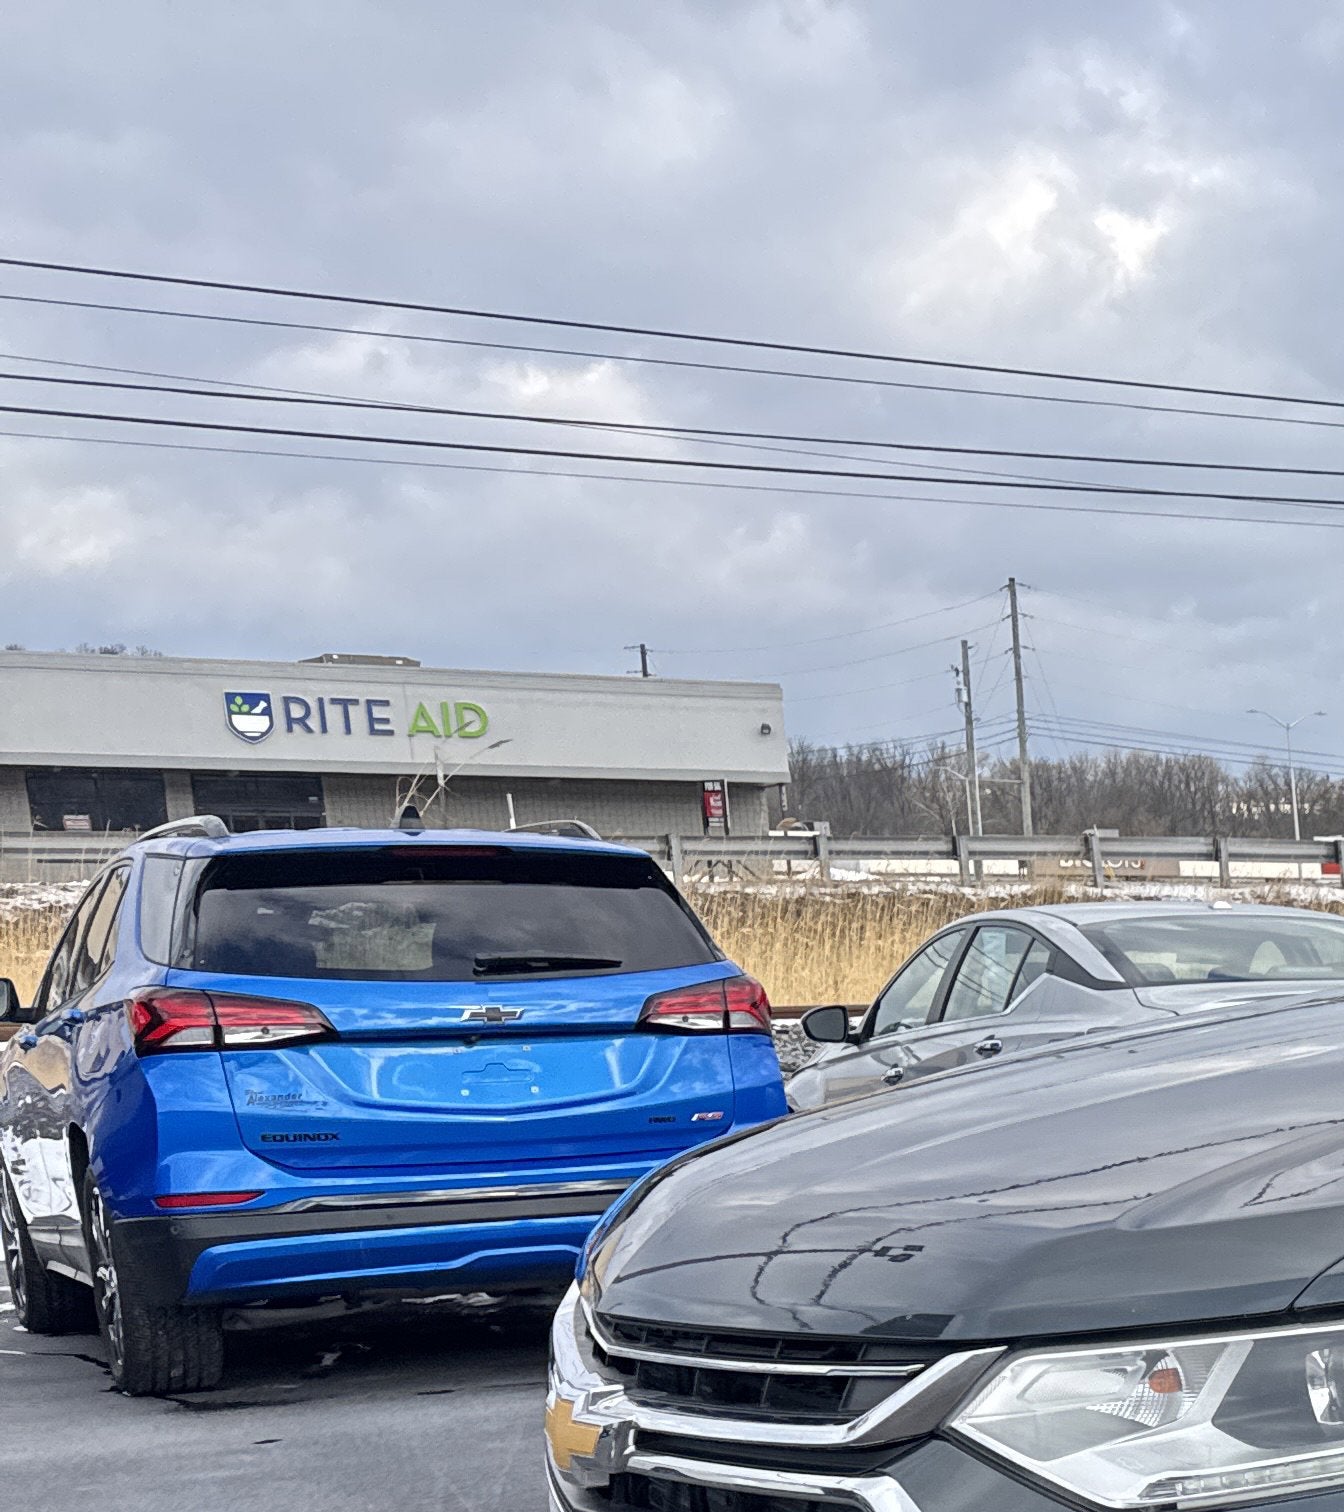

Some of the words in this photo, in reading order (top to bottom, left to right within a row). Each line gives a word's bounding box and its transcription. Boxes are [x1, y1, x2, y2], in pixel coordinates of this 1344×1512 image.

[282, 696, 395, 736] RITE
[408, 701, 489, 738] AID
[260, 1133, 341, 1142] EQUINOX
